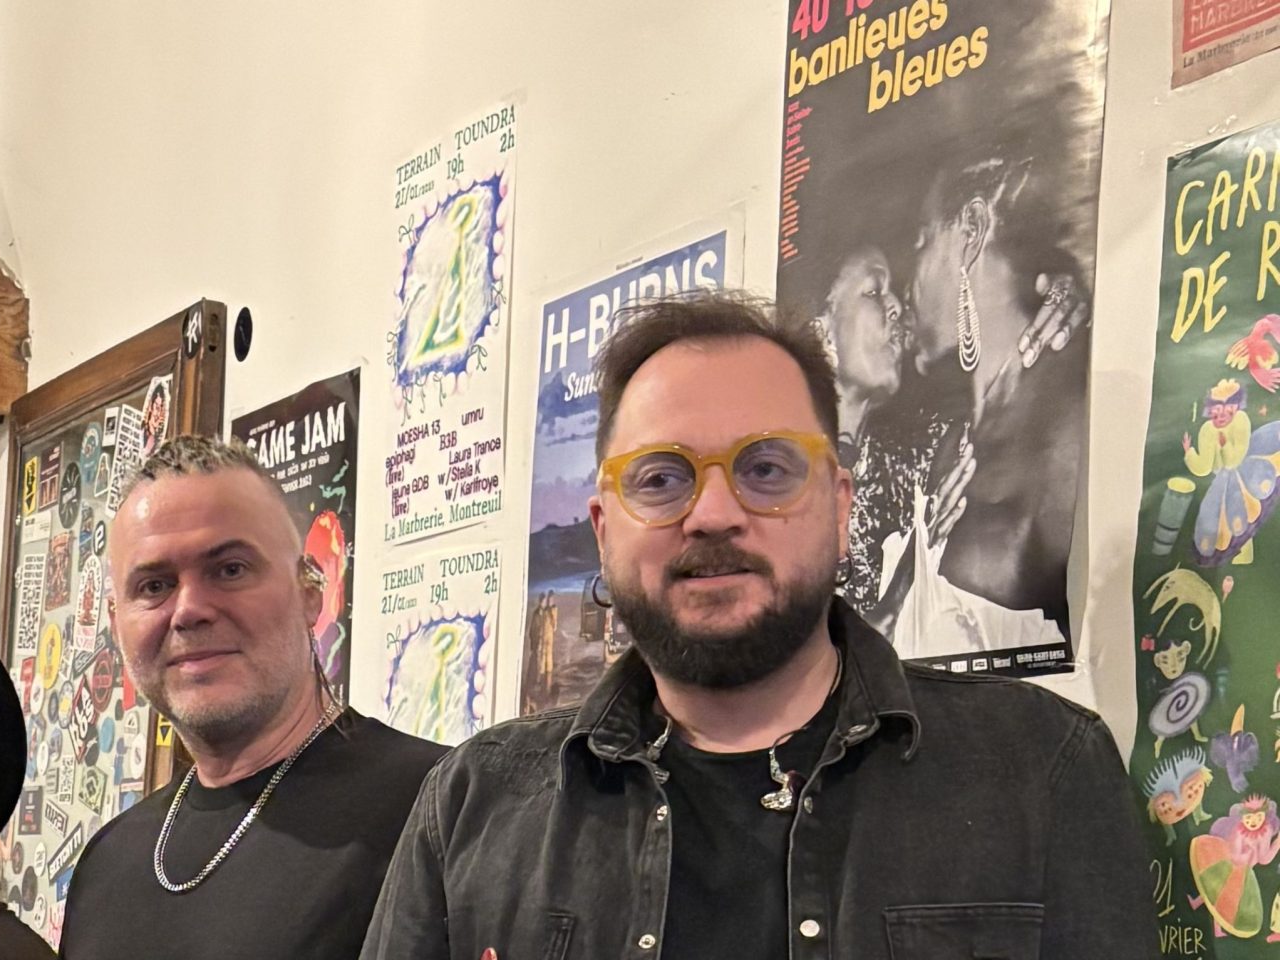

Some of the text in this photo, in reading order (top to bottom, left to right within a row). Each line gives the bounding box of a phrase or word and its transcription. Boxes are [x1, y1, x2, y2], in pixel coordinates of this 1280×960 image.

[788, 0, 948, 98] banlieues
[868, 26, 989, 113] bleues
[396, 104, 515, 186] TERRAIN TOUNDRA
[500, 128, 515, 153] 2h
[1175, 147, 1280, 256] CAR
[1171, 251, 1230, 343] DE
[301, 401, 347, 455] JAM
[449, 437, 501, 465] Laura Trance
[384, 523, 396, 542] La
[449, 490, 502, 525] Montreuil
[383, 548, 499, 591] TERRAIN TOUNDRA
[484, 571, 498, 595] 2h
[1159, 918, 1207, 954] VRIER
